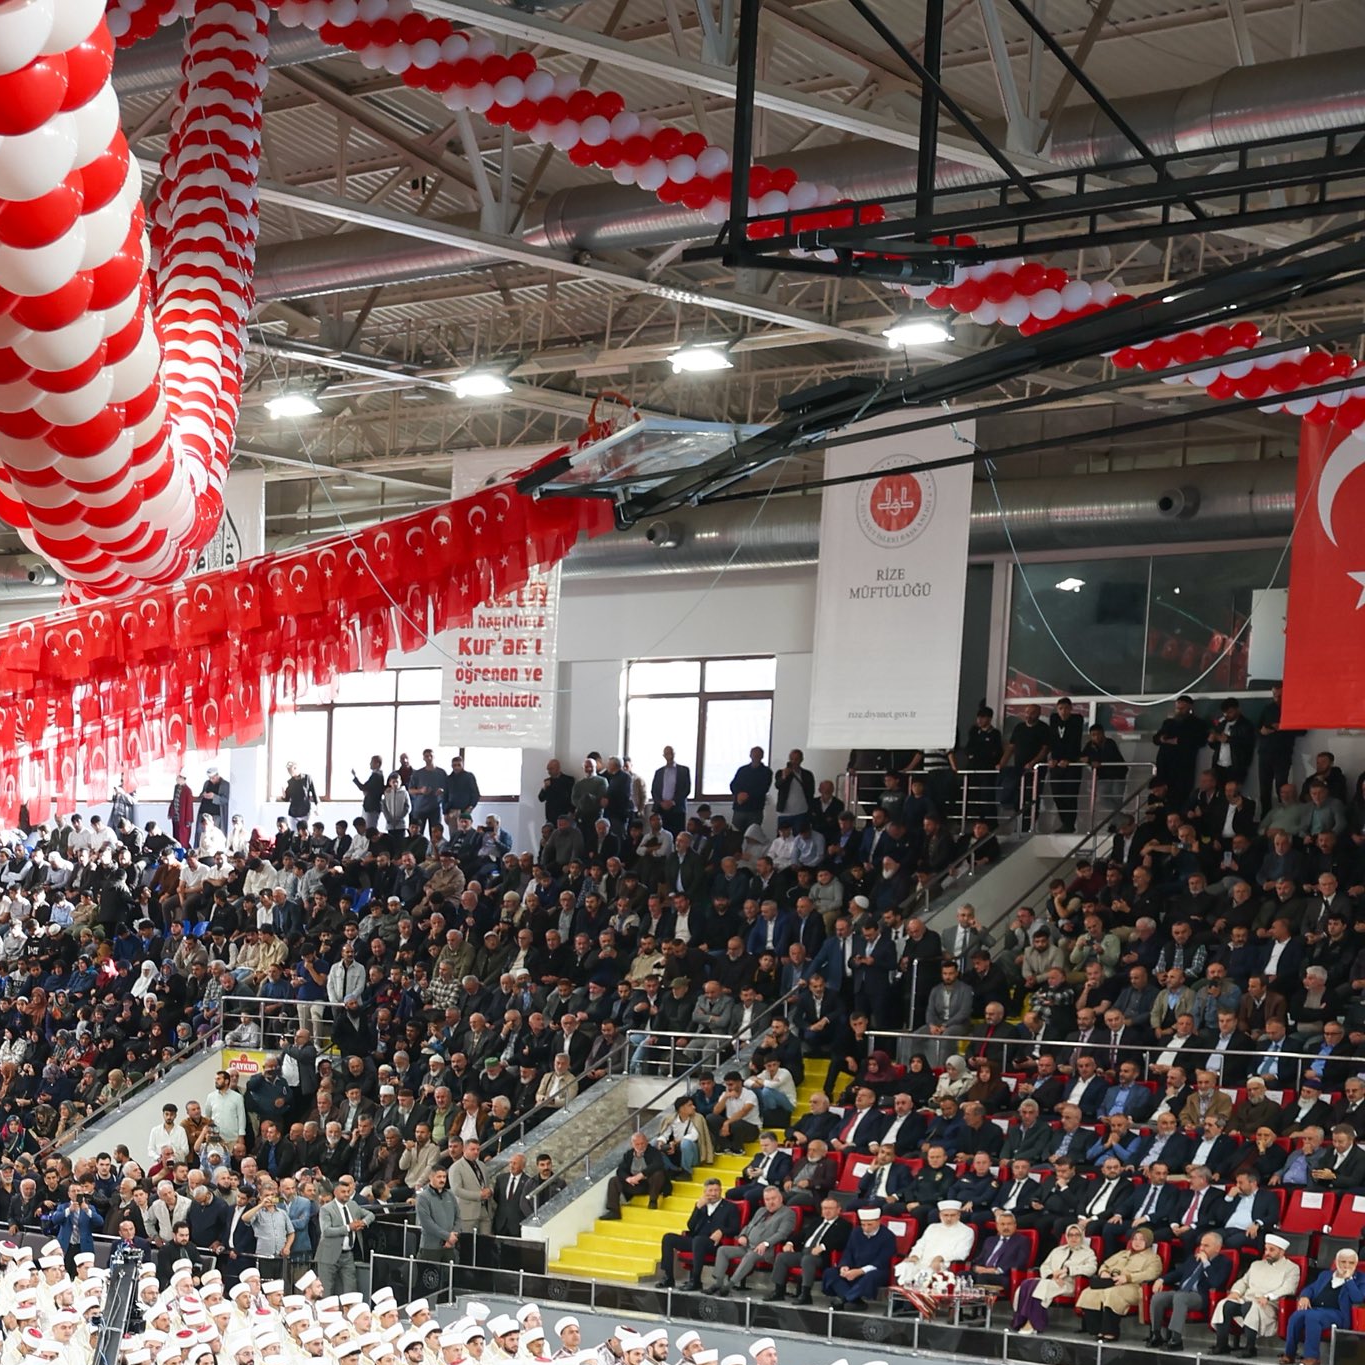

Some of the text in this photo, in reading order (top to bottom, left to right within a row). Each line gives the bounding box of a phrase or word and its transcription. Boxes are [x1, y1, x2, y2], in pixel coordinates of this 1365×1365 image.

[876, 567, 906, 581] RİZE
[849, 582, 932, 600] MÜFTÜLÜĞÜ
[456, 662, 542, 684] öğrenen ve
